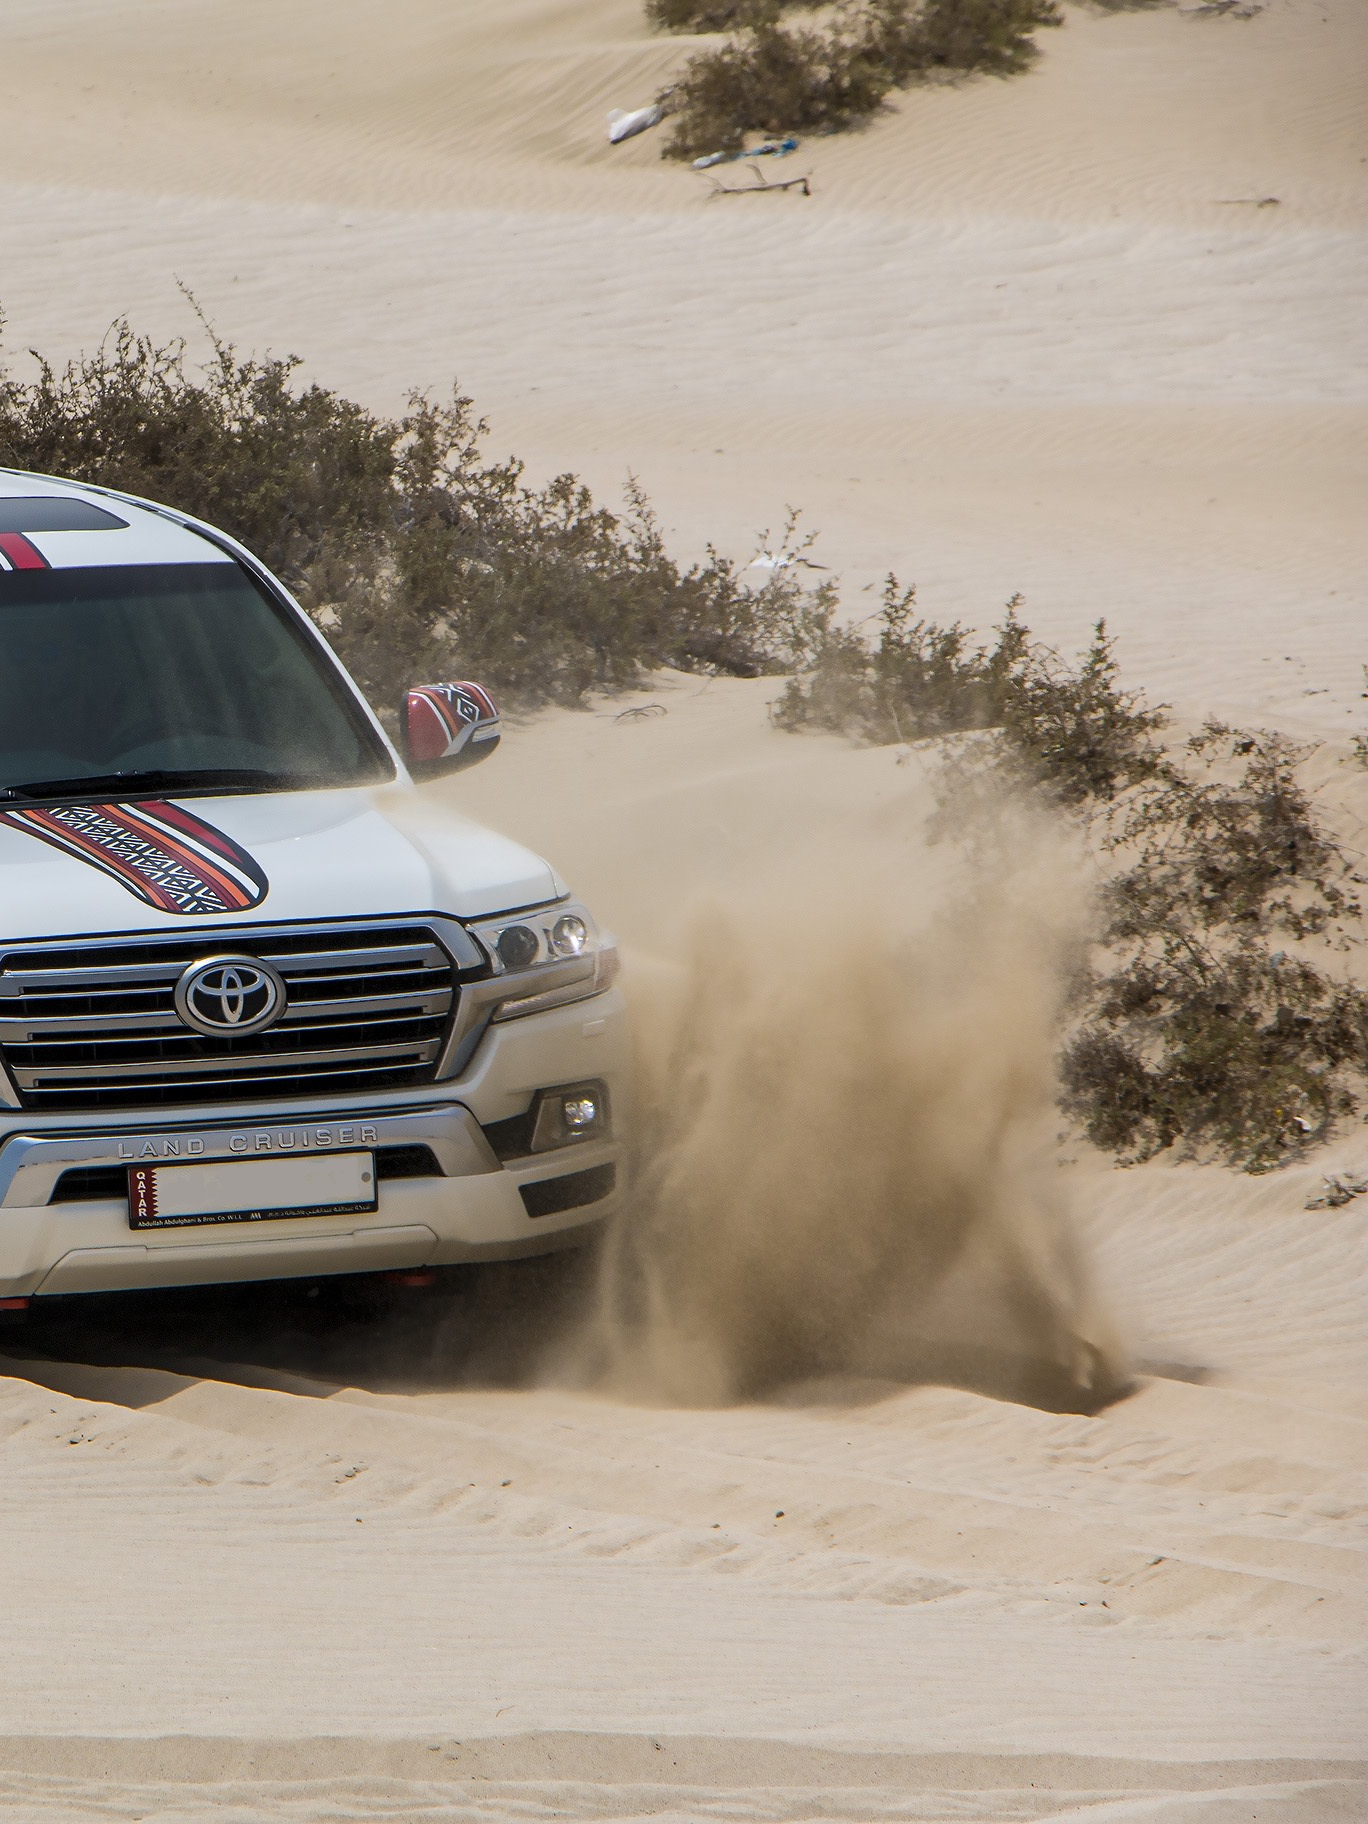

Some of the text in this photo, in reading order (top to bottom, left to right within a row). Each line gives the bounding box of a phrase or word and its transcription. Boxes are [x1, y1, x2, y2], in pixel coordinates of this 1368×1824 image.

[118, 1125, 378, 1158] LAND CRUISER
[136, 1171, 148, 1217] QATAR
